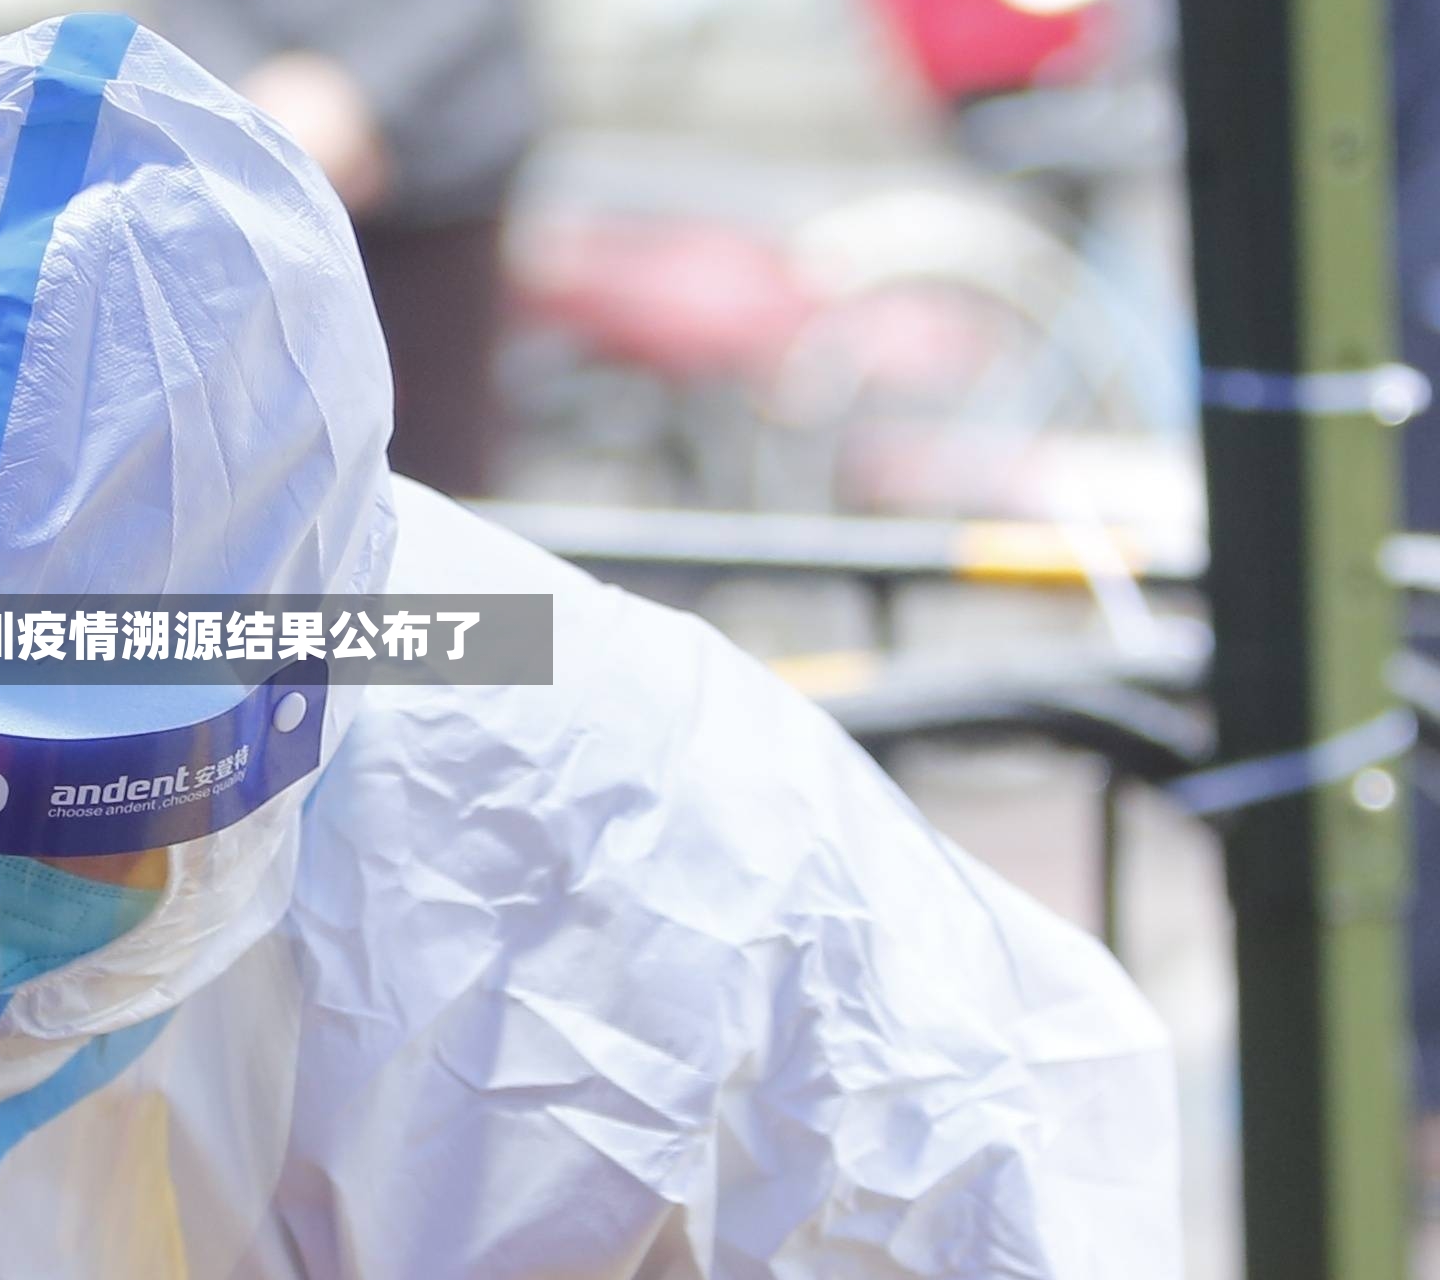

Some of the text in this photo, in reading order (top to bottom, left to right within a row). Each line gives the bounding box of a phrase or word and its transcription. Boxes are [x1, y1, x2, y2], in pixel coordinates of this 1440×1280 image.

[50, 744, 249, 806] andent 安登特
[48, 806, 102, 818] choose
